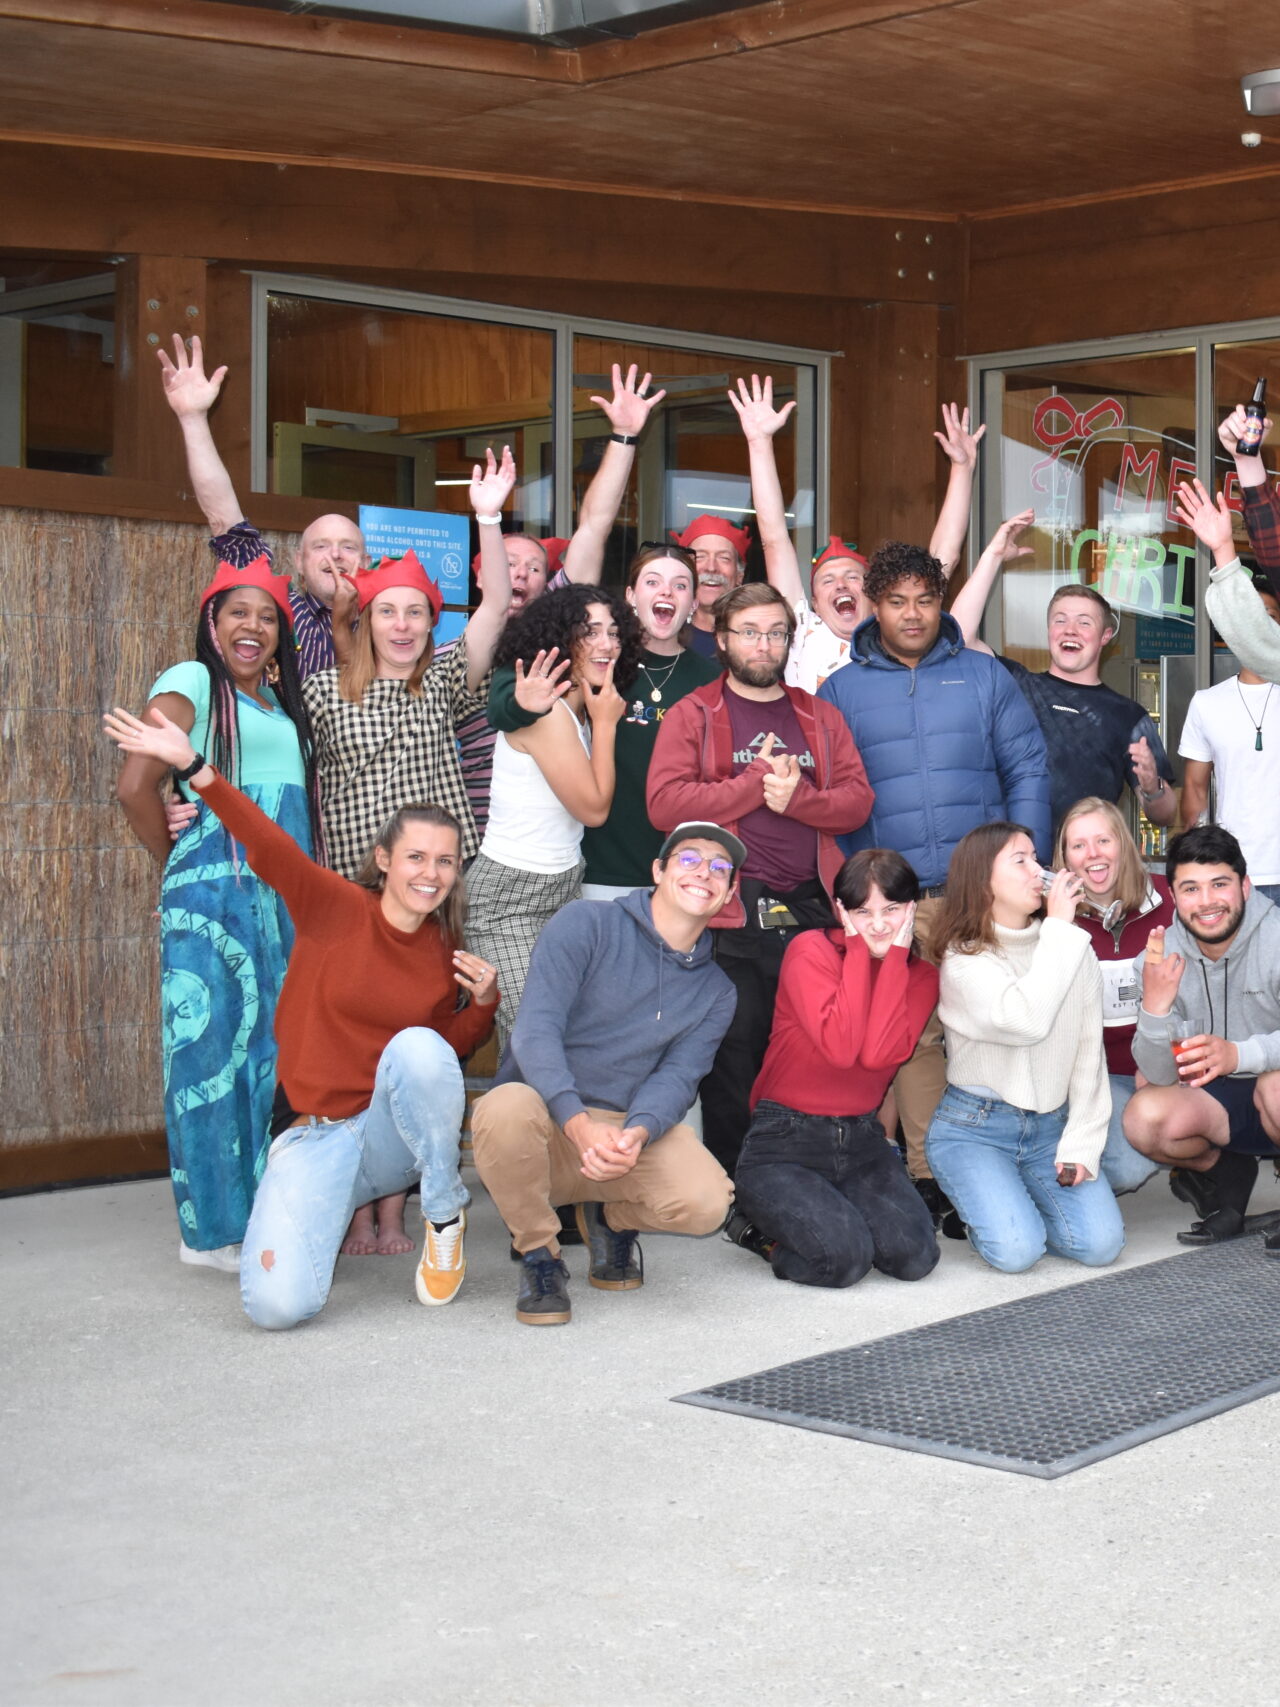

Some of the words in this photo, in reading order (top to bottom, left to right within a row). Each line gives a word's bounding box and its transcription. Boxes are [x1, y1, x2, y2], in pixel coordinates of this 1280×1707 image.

[380, 524, 392, 532] ARE
[393, 525, 406, 533] NOT
[407, 527, 440, 537] PERMITTED
[441, 530, 449, 538] TO
[366, 534, 385, 543] BRING
[387, 536, 414, 546] ALCOHOL
[415, 539, 432, 547] ONTO
[433, 541, 447, 549] THIS
[366, 546, 390, 554] TEKAPO
